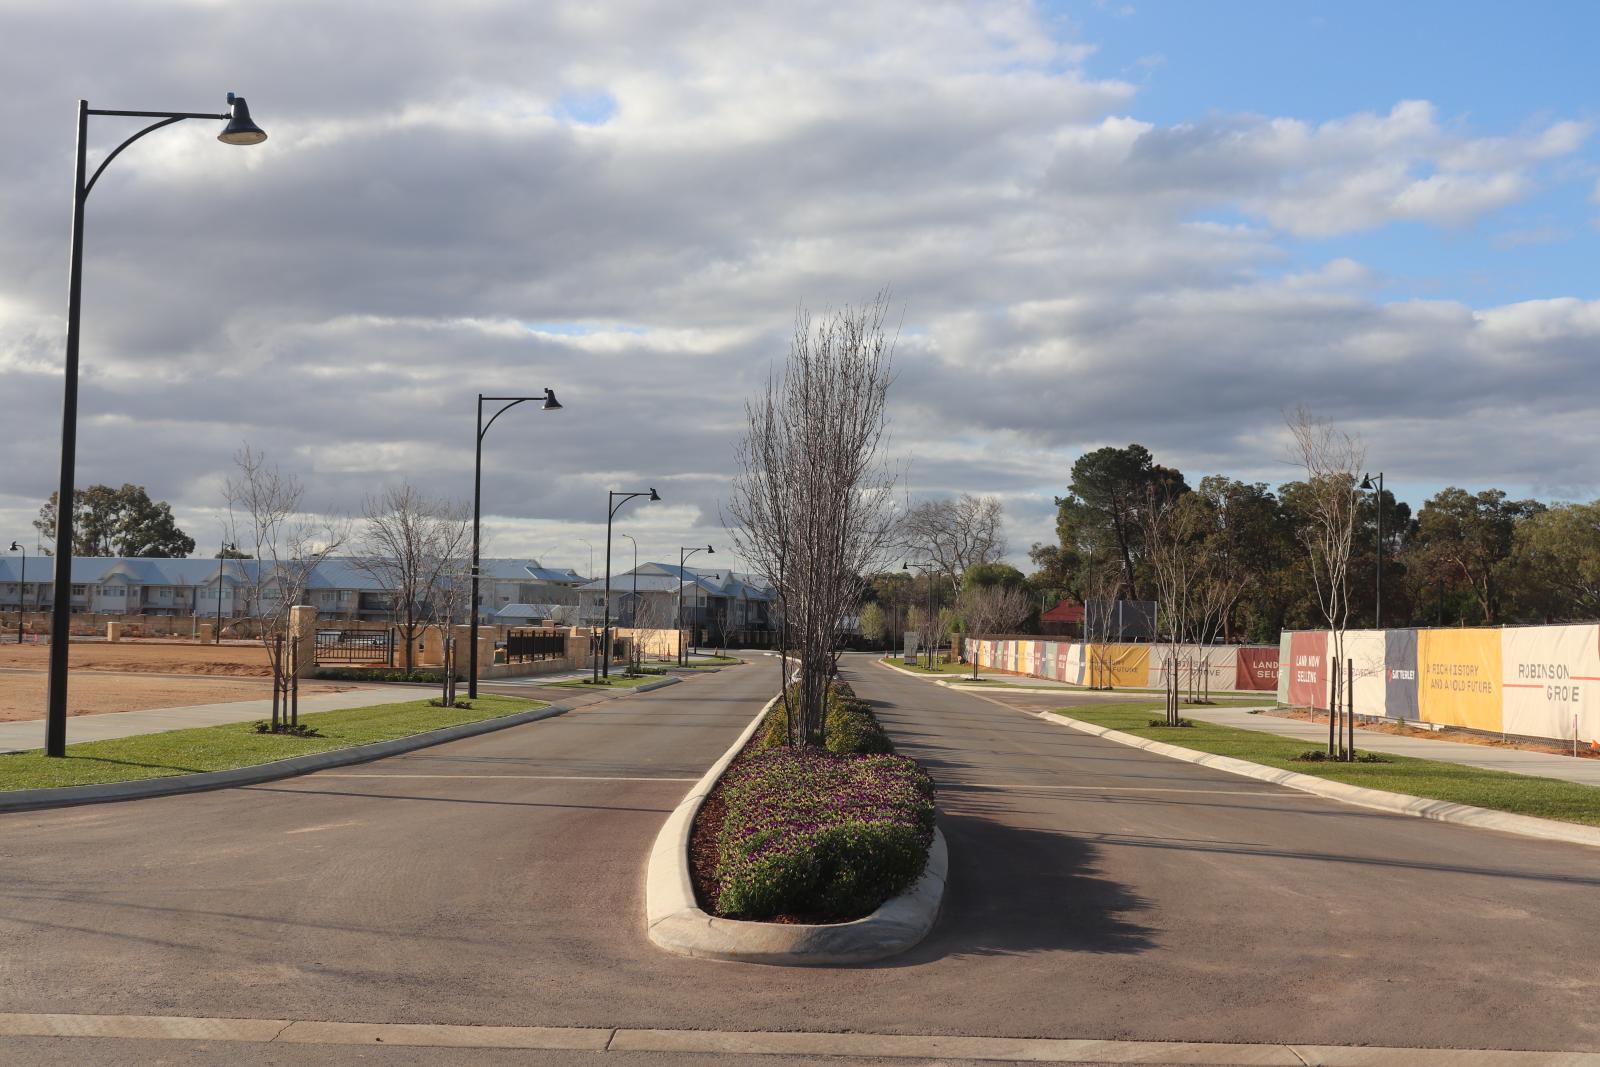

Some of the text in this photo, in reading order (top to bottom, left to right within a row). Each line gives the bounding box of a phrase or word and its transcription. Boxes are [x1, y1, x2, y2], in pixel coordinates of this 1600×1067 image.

[1253, 660, 1279, 669] LAND
[1518, 664, 1569, 679] ROBINSON
[1297, 670, 1317, 684] SELLING
